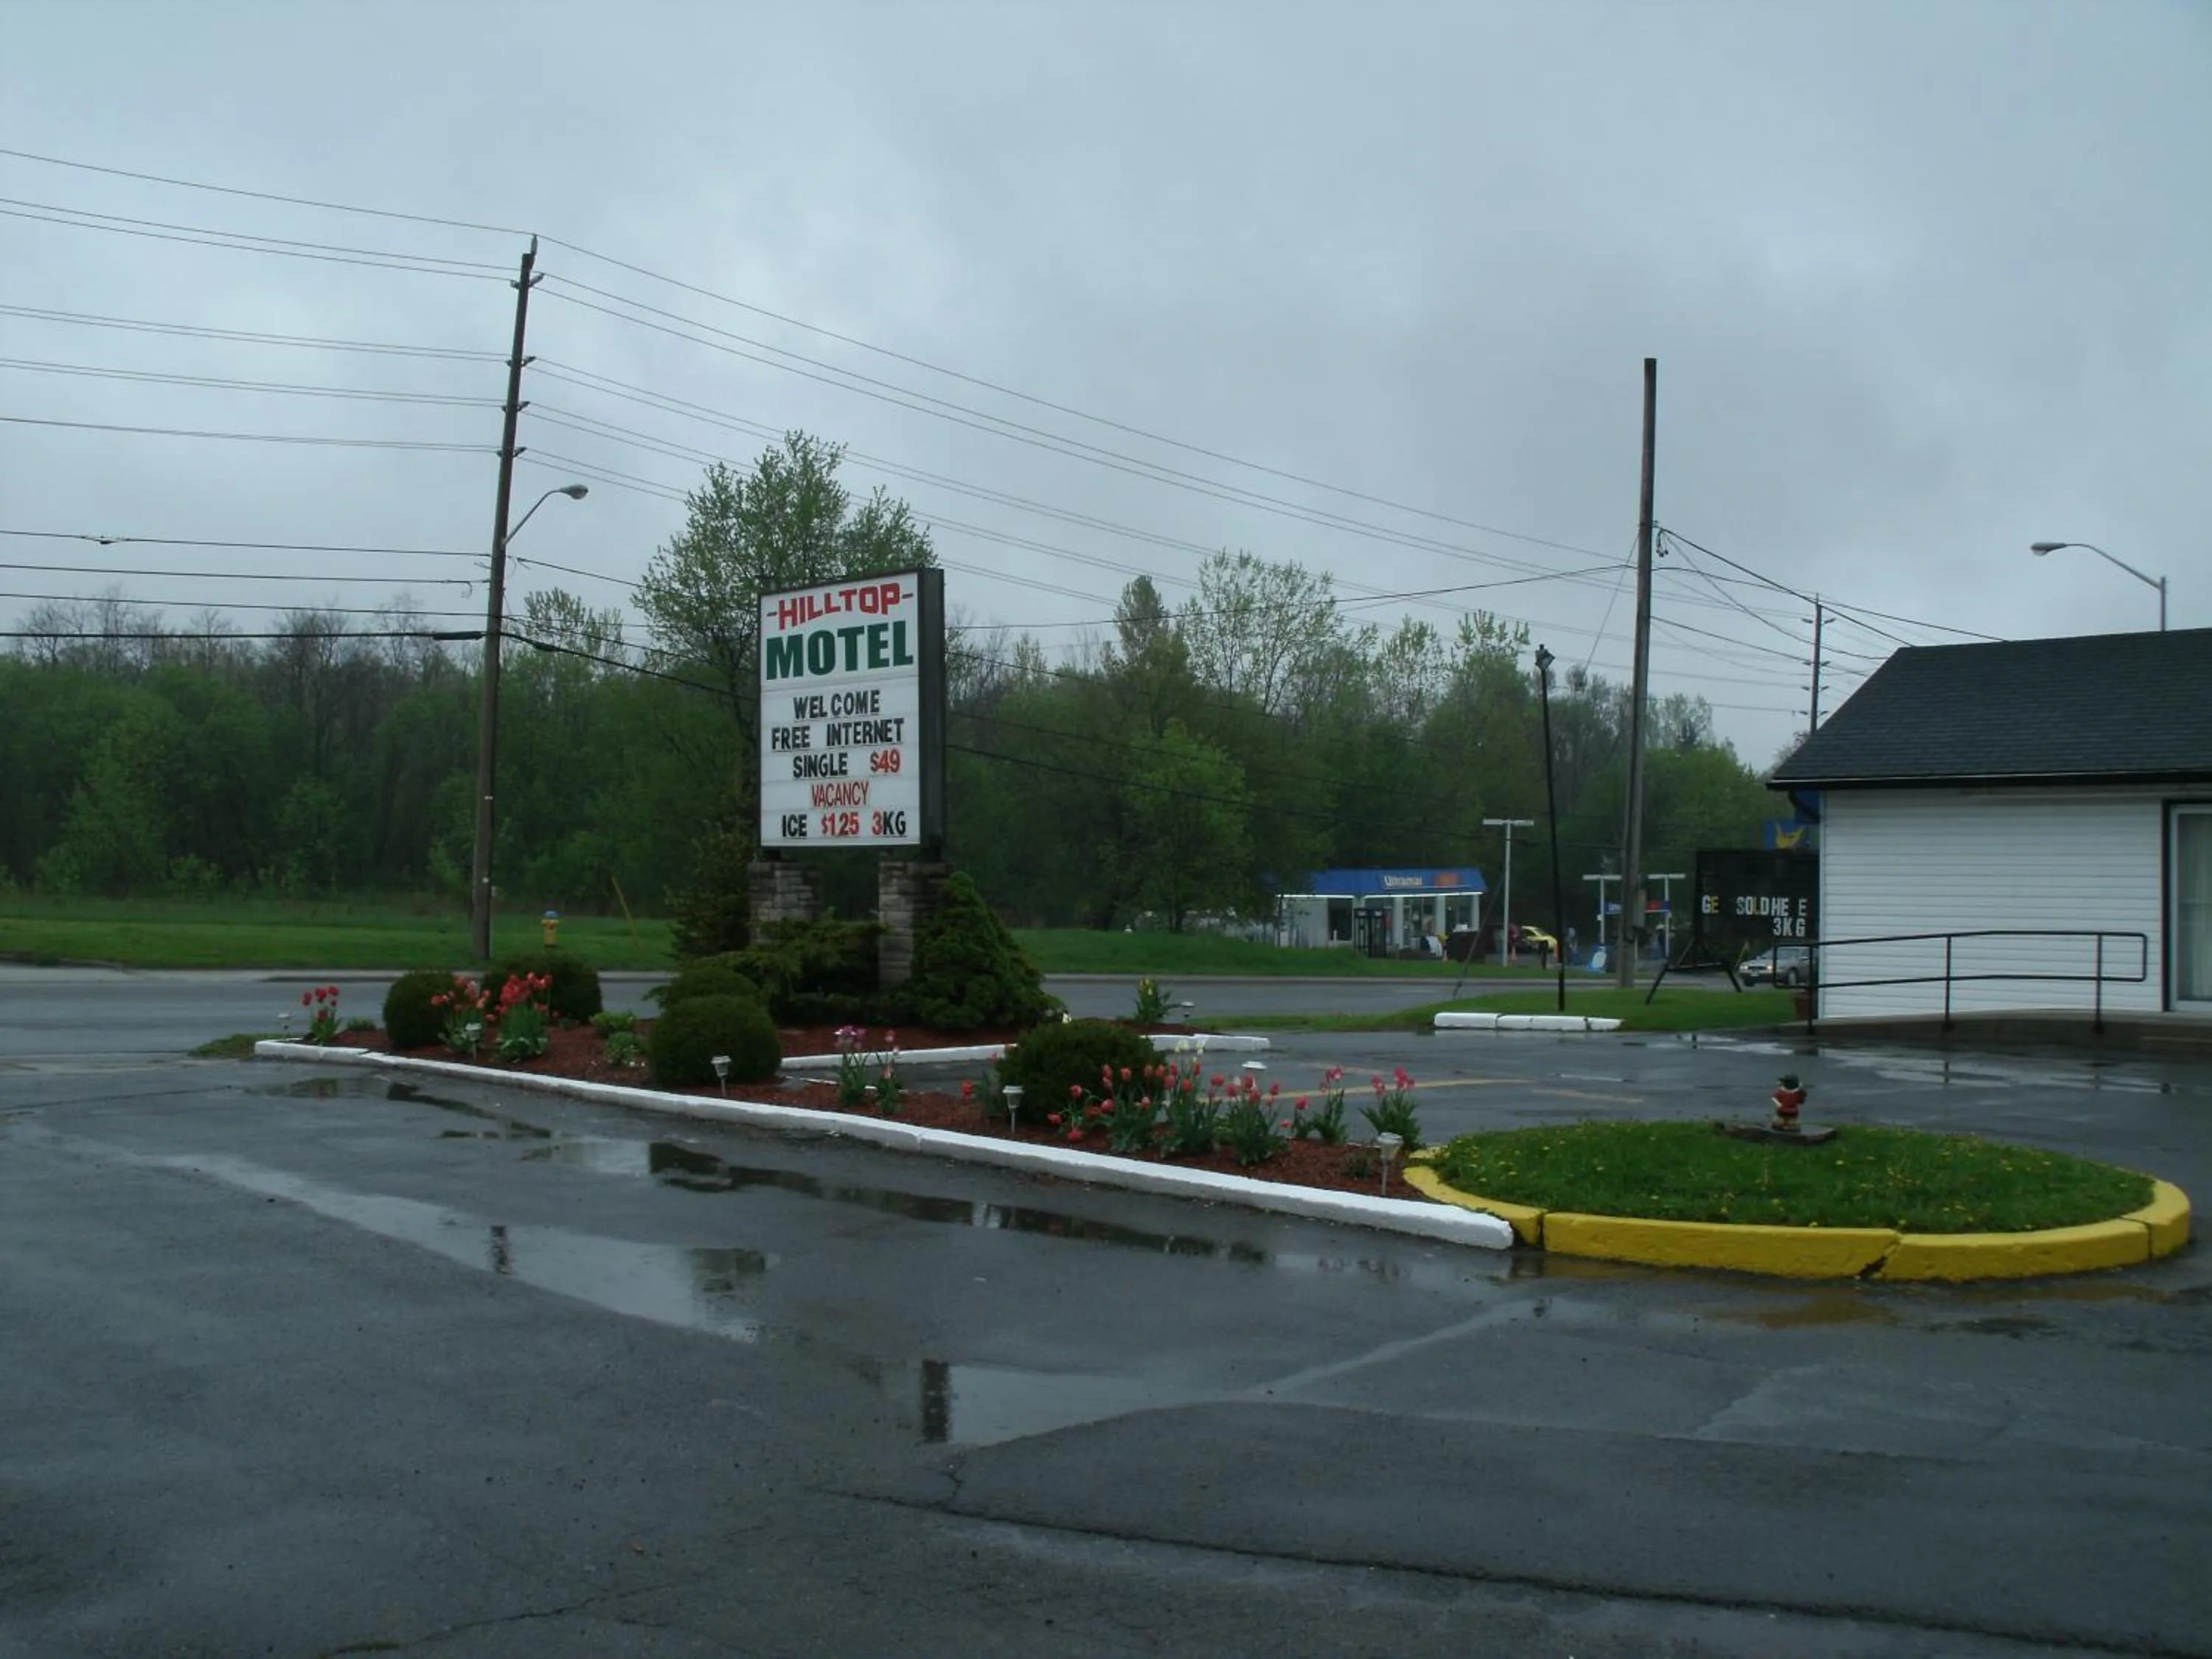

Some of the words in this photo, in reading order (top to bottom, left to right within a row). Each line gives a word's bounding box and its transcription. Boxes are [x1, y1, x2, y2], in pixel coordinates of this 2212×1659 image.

[766, 621, 914, 680] MOTEL
[793, 690, 880, 720] WELCOME
[772, 725, 810, 749] FREE
[827, 718, 905, 746] INTERNET
[793, 753, 848, 778] SINGLE
[870, 748, 900, 773] $49
[812, 781, 870, 807] VACANCY
[782, 815, 807, 837] ICE
[872, 811, 906, 835] 3KG
[1773, 917, 1806, 937] 3KG
